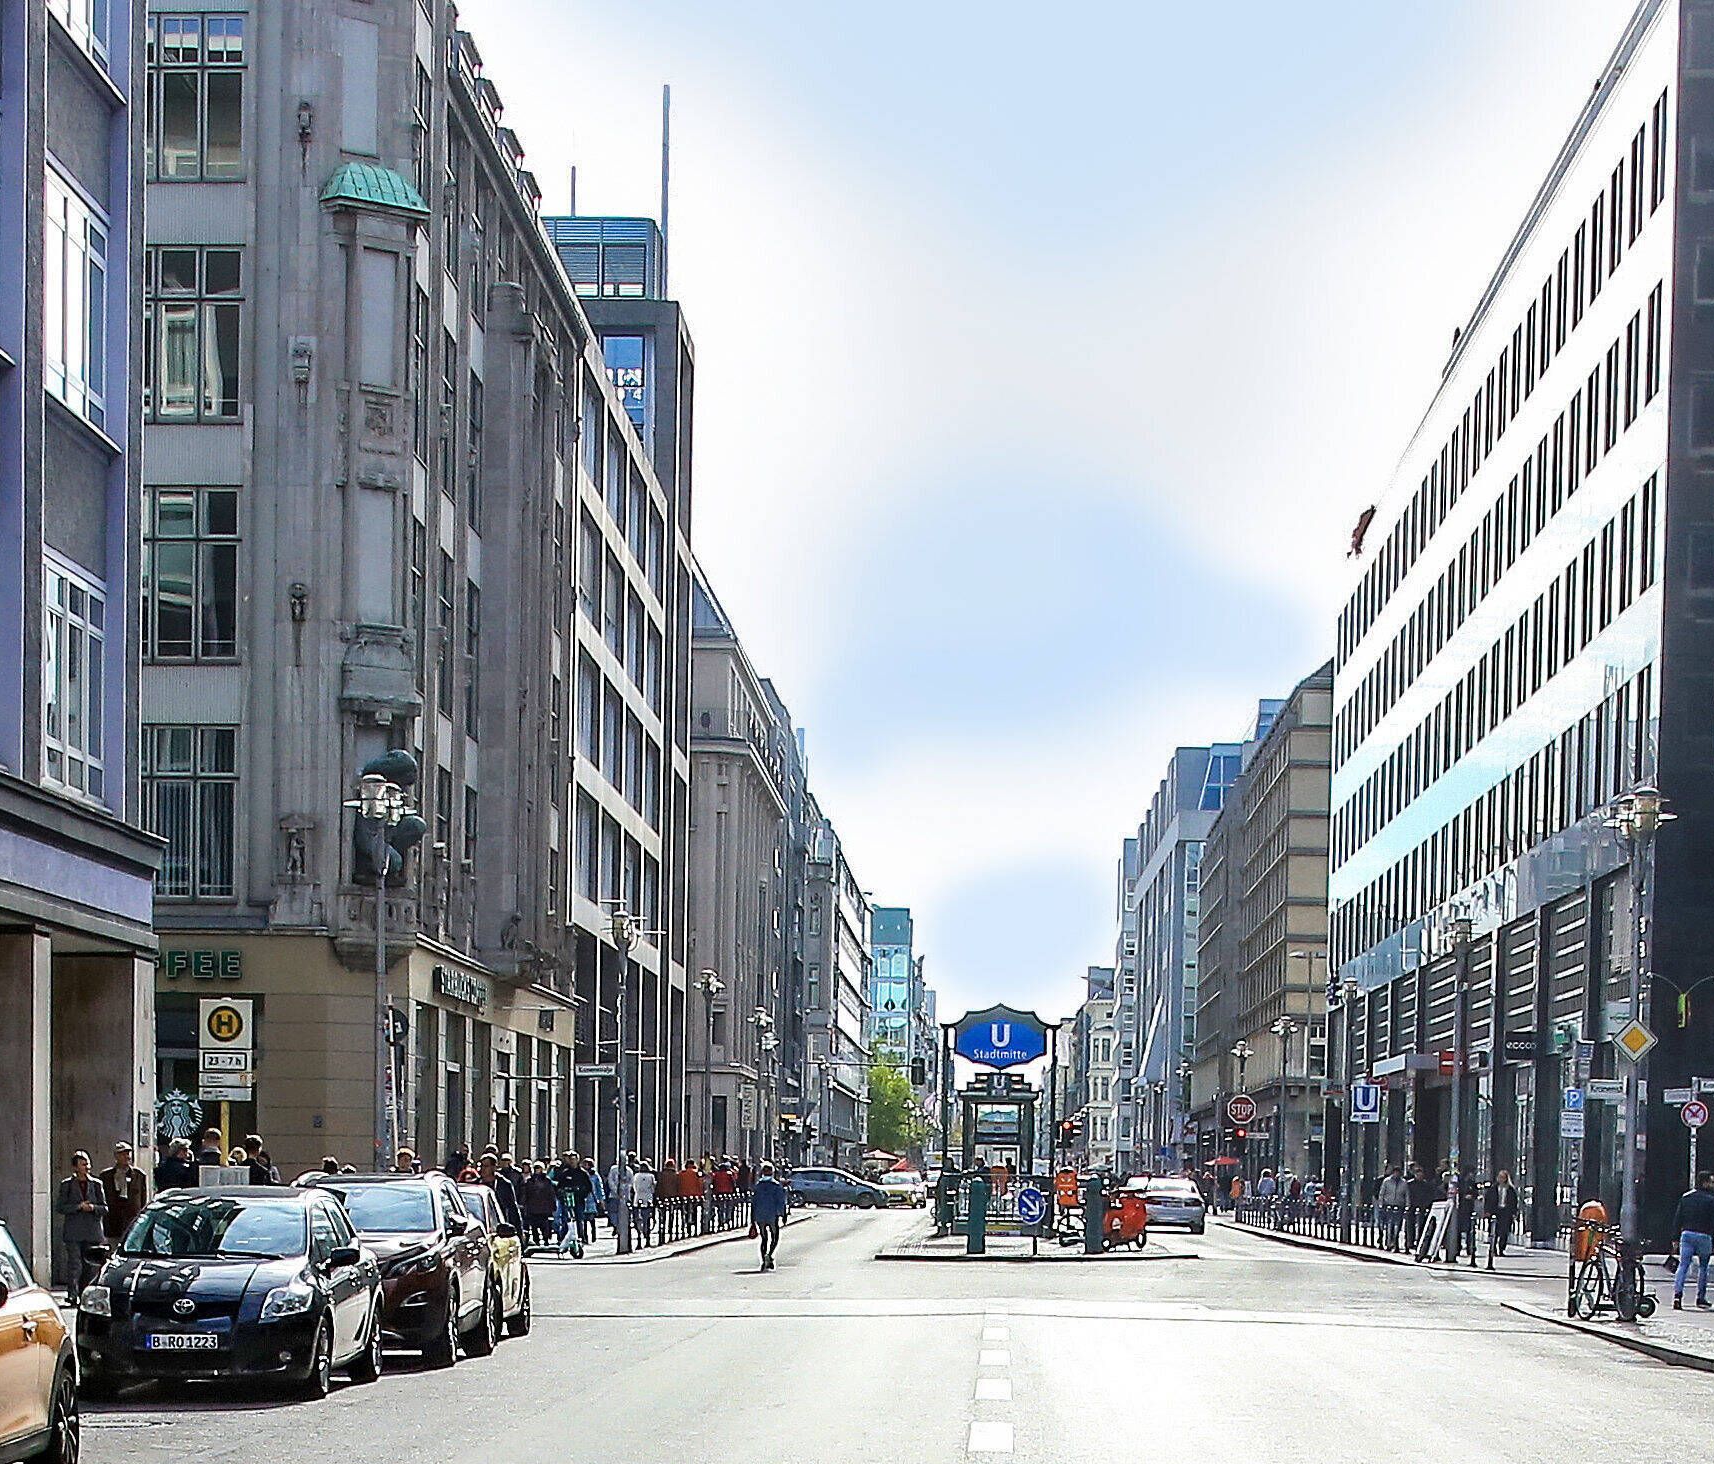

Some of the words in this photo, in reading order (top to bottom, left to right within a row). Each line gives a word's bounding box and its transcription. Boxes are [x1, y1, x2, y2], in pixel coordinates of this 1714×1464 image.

[216, 1015, 233, 1034] H
[991, 1023, 1011, 1048] U
[208, 1056, 219, 1066] 23
[227, 1056, 234, 1066] 7
[974, 1049, 1027, 1059] Stadtmitte
[994, 1075, 1005, 1089] U
[1356, 1087, 1376, 1111] U
[1569, 1091, 1580, 1107] P
[1230, 1103, 1253, 1115] STOP
[152, 1336, 161, 1348] B
[186, 1335, 217, 1348] 1223
